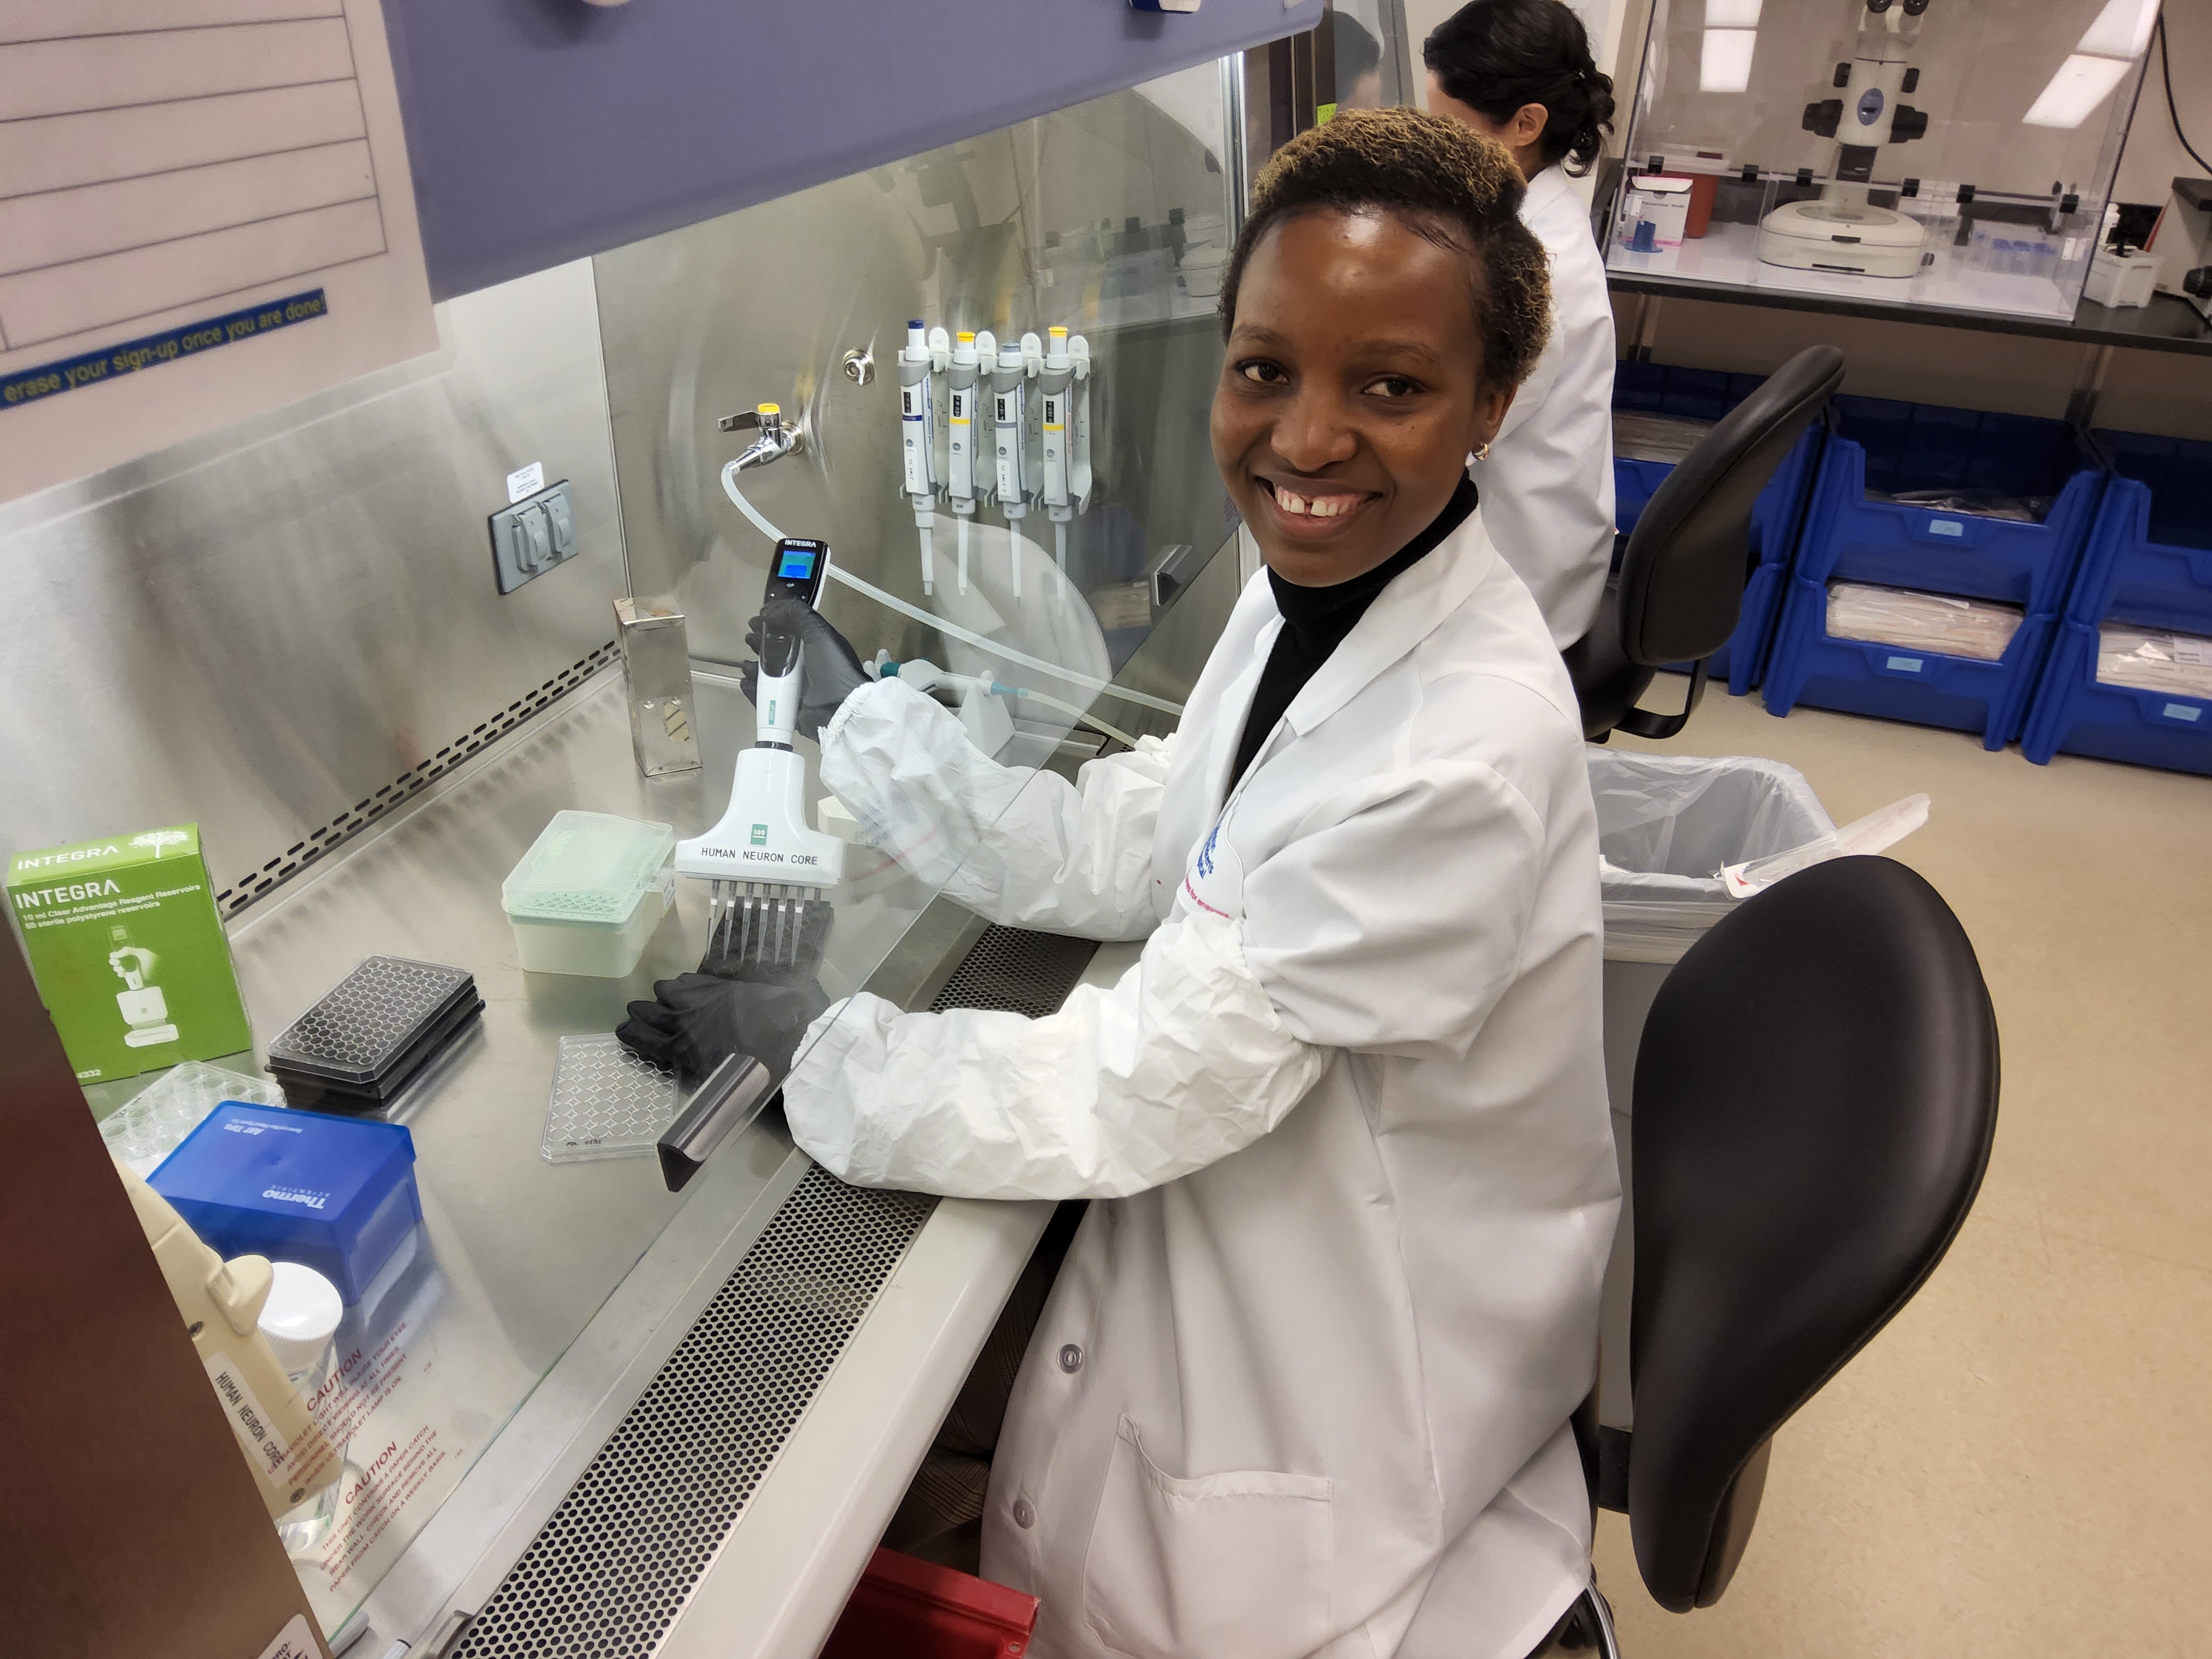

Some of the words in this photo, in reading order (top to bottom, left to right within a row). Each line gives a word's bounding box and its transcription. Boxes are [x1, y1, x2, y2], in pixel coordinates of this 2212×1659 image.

[4, 373, 59, 402] erase
[65, 360, 107, 390] your
[112, 340, 178, 370] sign-up
[182, 326, 221, 350] once
[226, 319, 254, 342] you
[259, 310, 281, 327] are
[286, 293, 326, 320] done!
[784, 540, 817, 548] INTEGRA
[18, 846, 118, 870] INTEGRA
[701, 847, 736, 859] HUMAN
[743, 851, 784, 862] NEURON
[790, 855, 818, 865] CORE
[15, 879, 121, 909] INTEGRA
[38, 917, 65, 928] sterile
[66, 910, 116, 924] polystyrene
[117, 901, 161, 913] reservoirs
[47, 908, 71, 918] Clear
[72, 901, 117, 915] Advantage
[119, 893, 155, 907] Reagent
[155, 884, 200, 899] Reservoirs
[263, 1190, 326, 1209] Thermo
[268, 1424, 313, 1475] ULTRAVIOLET
[313, 1402, 332, 1426] LIGHT
[373, 1340, 390, 1361] YOUR
[306, 1347, 362, 1412] CAUTION
[329, 1409, 356, 1441] SHOULD
[356, 1394, 370, 1412] NOT
[370, 1382, 380, 1396] BE
[215, 1372, 243, 1406] HUMAN
[237, 1403, 267, 1441] NEURON
[263, 1441, 285, 1467] CORE
[286, 1446, 308, 1472] AVOID
[307, 1418, 333, 1449] DIRECT
[332, 1388, 360, 1421] VIEWING
[360, 1379, 368, 1391] AT
[369, 1366, 380, 1382] ALL
[304, 1459, 326, 1486] WHEN
[325, 1414, 367, 1462] ULTRAVIOLET
[366, 1394, 384, 1416] LAMP
[384, 1386, 391, 1396] IS
[320, 1542, 342, 1571] UNDER
[342, 1526, 356, 1544] THE
[356, 1503, 375, 1528] WORK
[375, 1470, 403, 1505] SURFACE
[402, 1444, 425, 1472] BEHIND
[425, 1429, 437, 1445] THE
[322, 1533, 337, 1551] THIS
[337, 1514, 353, 1534] UNIT
[353, 1477, 384, 1516] CONTAINS
[388, 1448, 408, 1474] PAPER
[408, 1424, 428, 1450] CATCH
[345, 1440, 397, 1505] CAUTION
[329, 1553, 347, 1576] REAR
[366, 1504, 388, 1532] CHECK
[388, 1488, 401, 1505] AND
[401, 1458, 426, 1490] REMOVE
[425, 1446, 436, 1460] ALL
[329, 1565, 350, 1592] PAPER
[350, 1542, 369, 1567] FROM
[369, 1517, 391, 1544] CATCH
[390, 1505, 400, 1519] ON
[405, 1472, 428, 1500] WEEKLY
